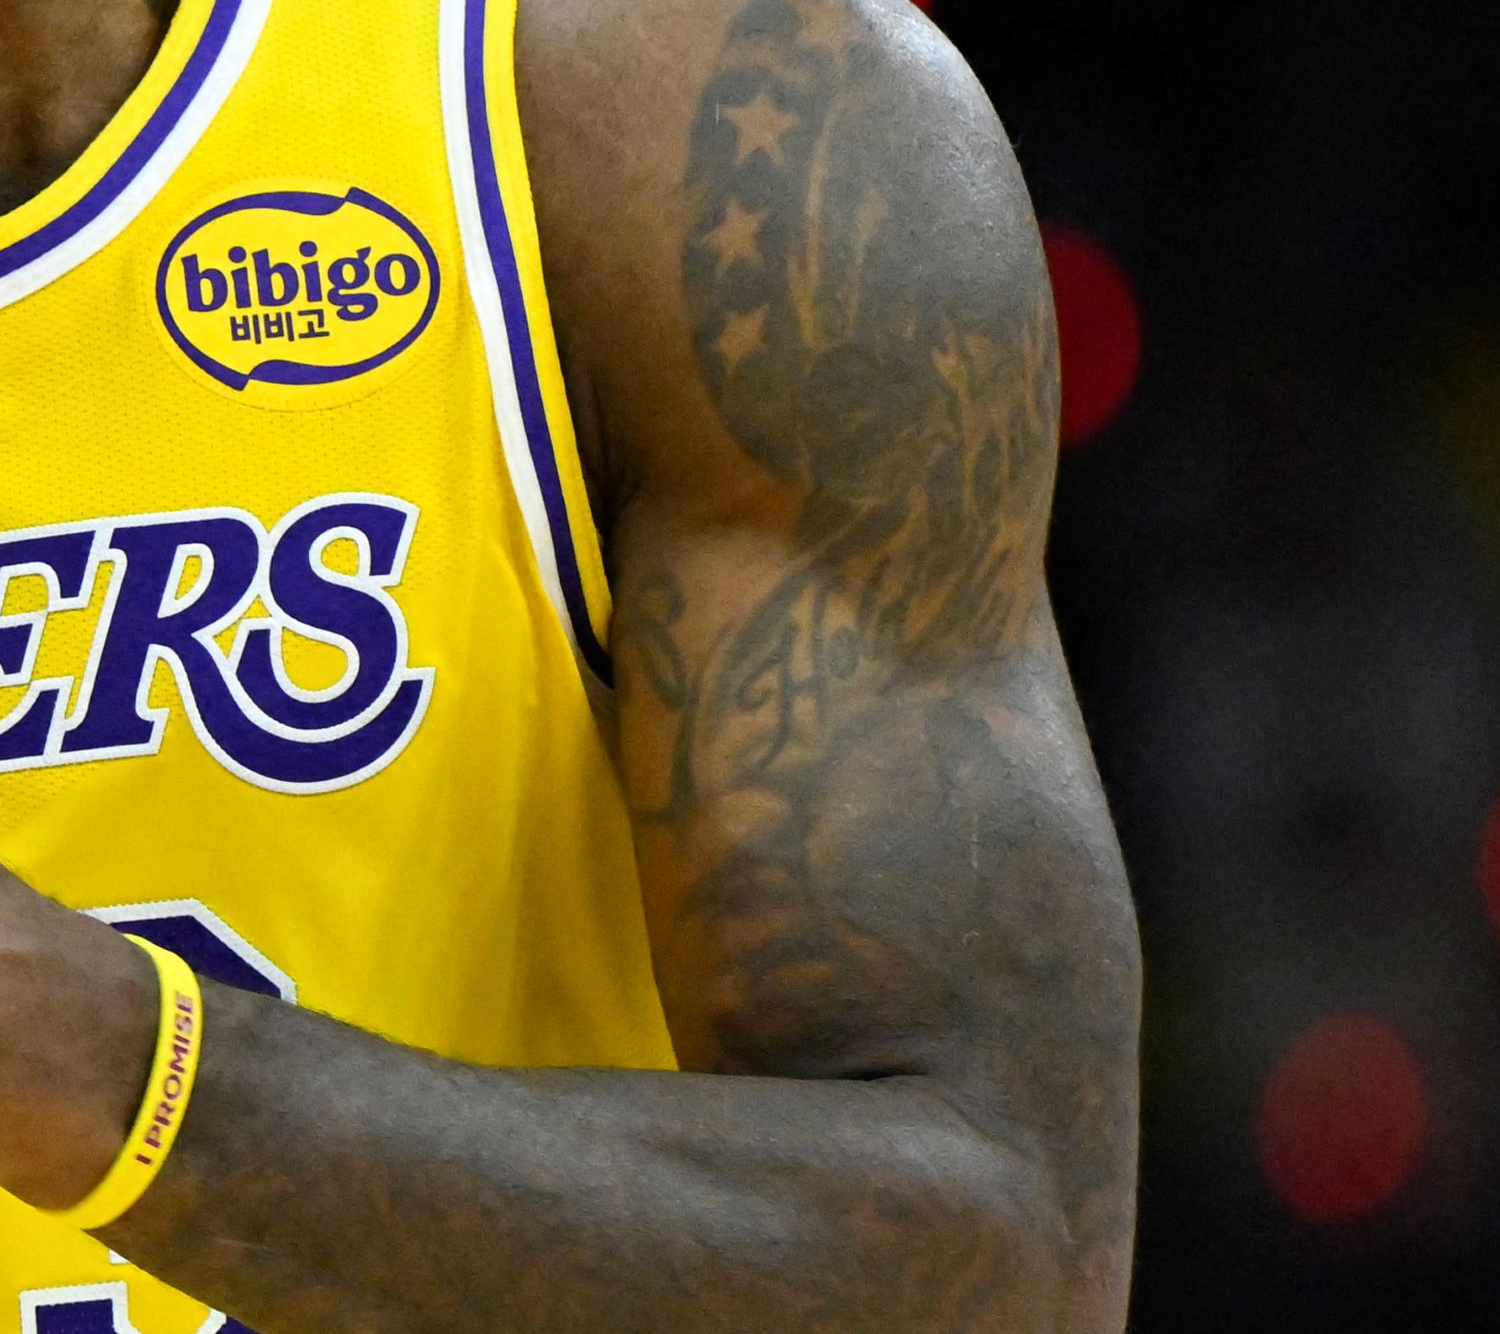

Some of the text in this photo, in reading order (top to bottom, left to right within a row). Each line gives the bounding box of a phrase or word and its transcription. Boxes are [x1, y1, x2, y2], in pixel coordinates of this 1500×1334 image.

[181, 240, 421, 321] bibigo
[229, 308, 330, 345] 비비고
[135, 990, 194, 1165] I PROMISE
